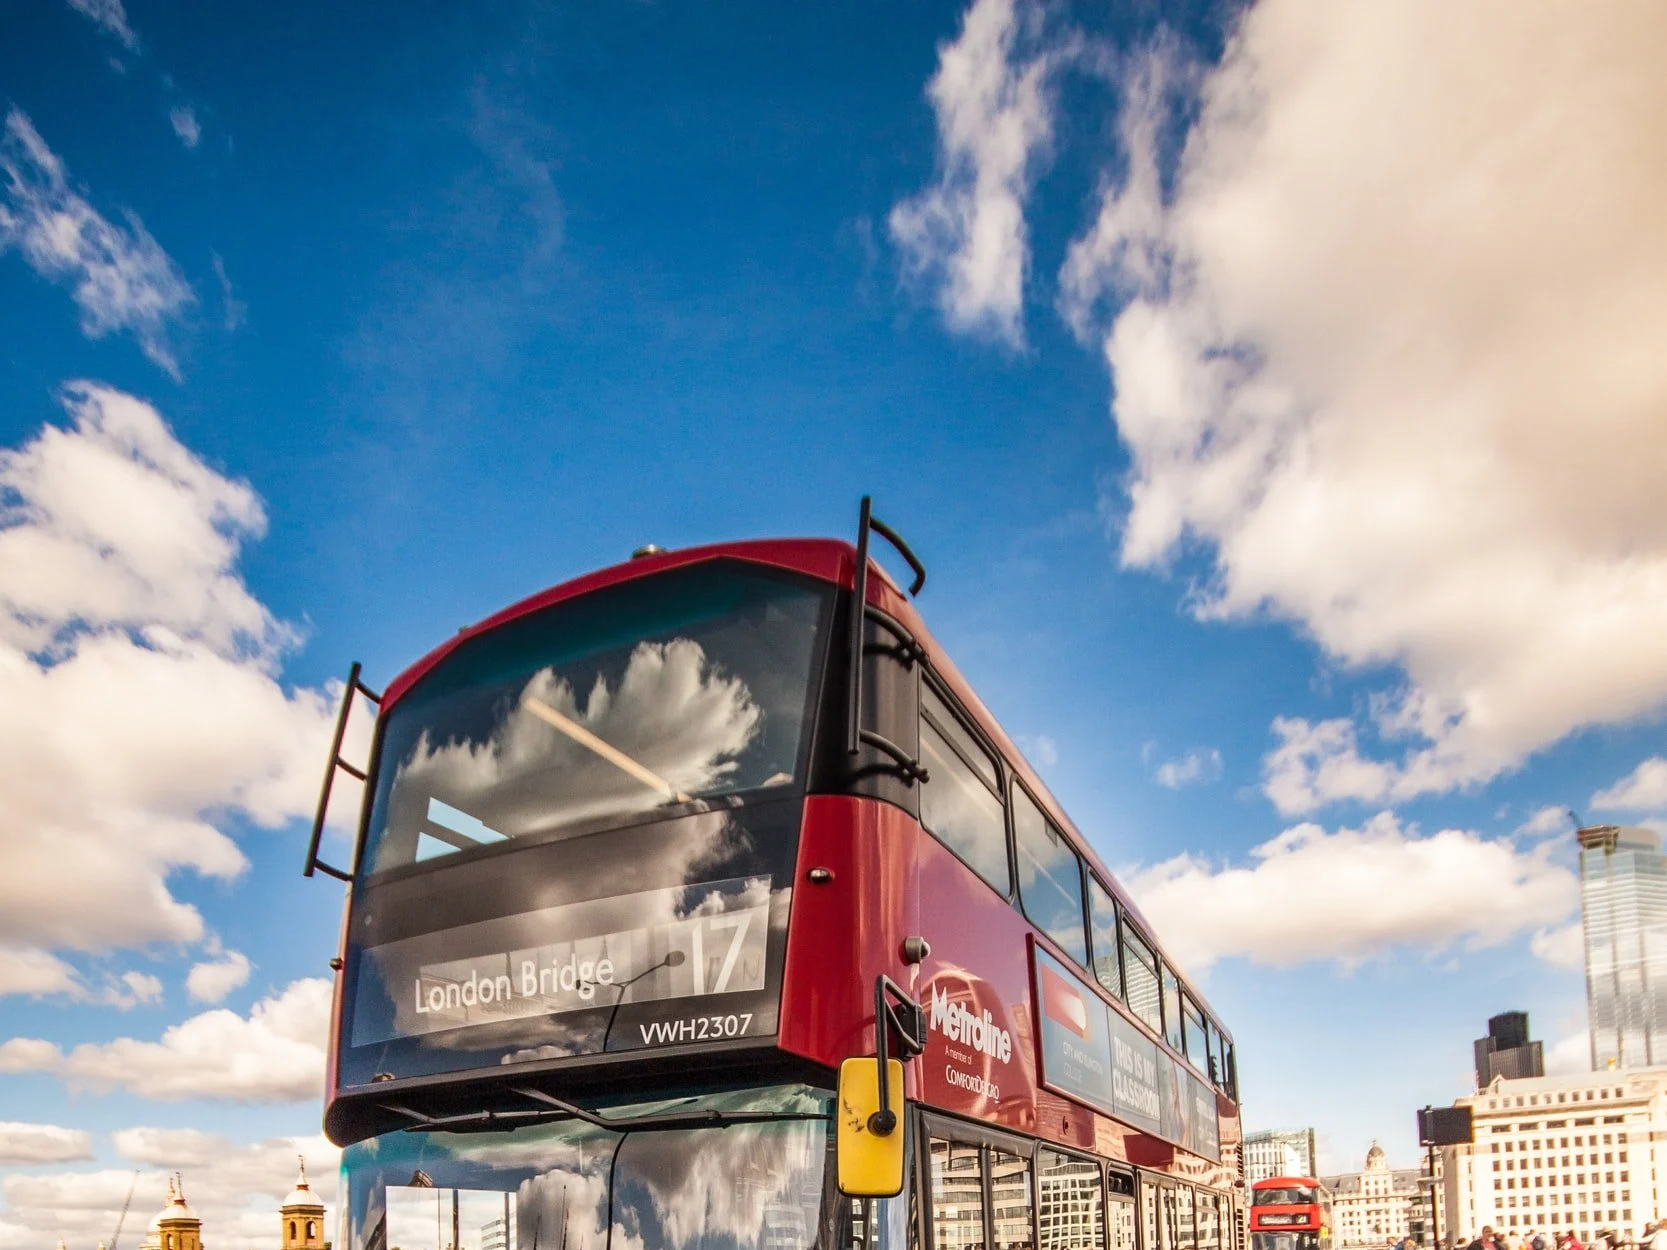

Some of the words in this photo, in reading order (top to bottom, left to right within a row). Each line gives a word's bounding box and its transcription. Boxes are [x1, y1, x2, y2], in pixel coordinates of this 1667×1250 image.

[692, 913, 752, 995] 17
[415, 969, 512, 1013] London
[521, 953, 614, 1000] Bridge
[639, 1013, 753, 1045] VWH2307
[930, 979, 1011, 1064] Metroline
[1113, 1036, 1133, 1073] THIS
[1134, 1050, 1143, 1079] IS
[1143, 1056, 1155, 1088] MY
[1112, 1069, 1160, 1120] CLASSROOM
